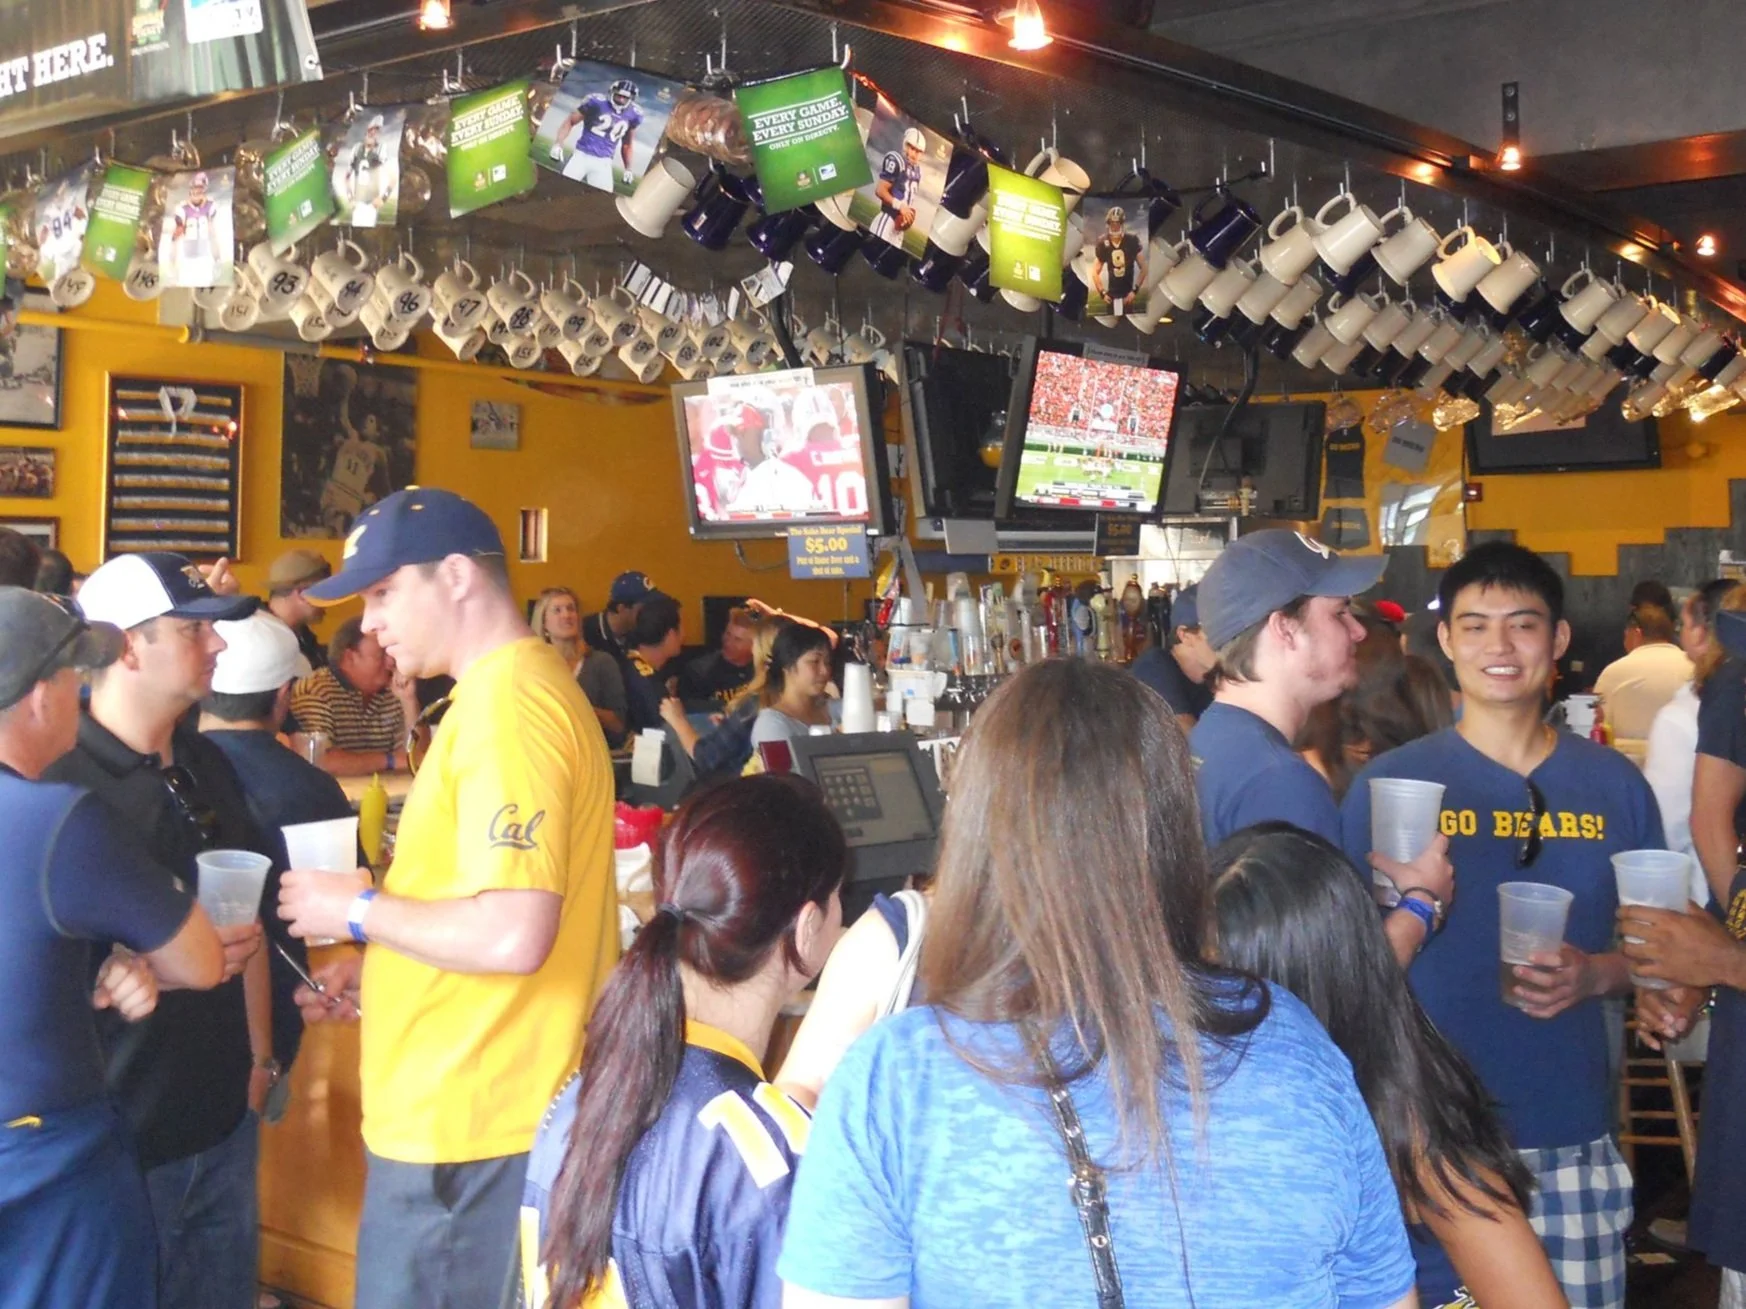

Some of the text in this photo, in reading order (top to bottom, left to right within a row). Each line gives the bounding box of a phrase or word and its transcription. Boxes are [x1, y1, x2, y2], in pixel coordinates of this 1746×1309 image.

[33, 32, 114, 87] HERE.
[454, 109, 486, 130] EVERY
[752, 104, 849, 142] EVERY SUNDAY.
[754, 97, 843, 129] EVERY GAME.
[451, 121, 484, 143] EVERY
[590, 114, 629, 143] 20
[769, 141, 791, 151] ONLY
[792, 137, 804, 146] ON
[884, 158, 897, 174] 18
[1111, 249, 1126, 278] 9
[273, 271, 299, 294] 93
[399, 291, 420, 314] 96
[458, 299, 481, 318] 97
[511, 306, 534, 329] 98
[661, 326, 680, 339] 101
[805, 536, 848, 554] $5.00
[488, 803, 546, 850] Cal
[1440, 809, 1605, 840] GO BEARS!
